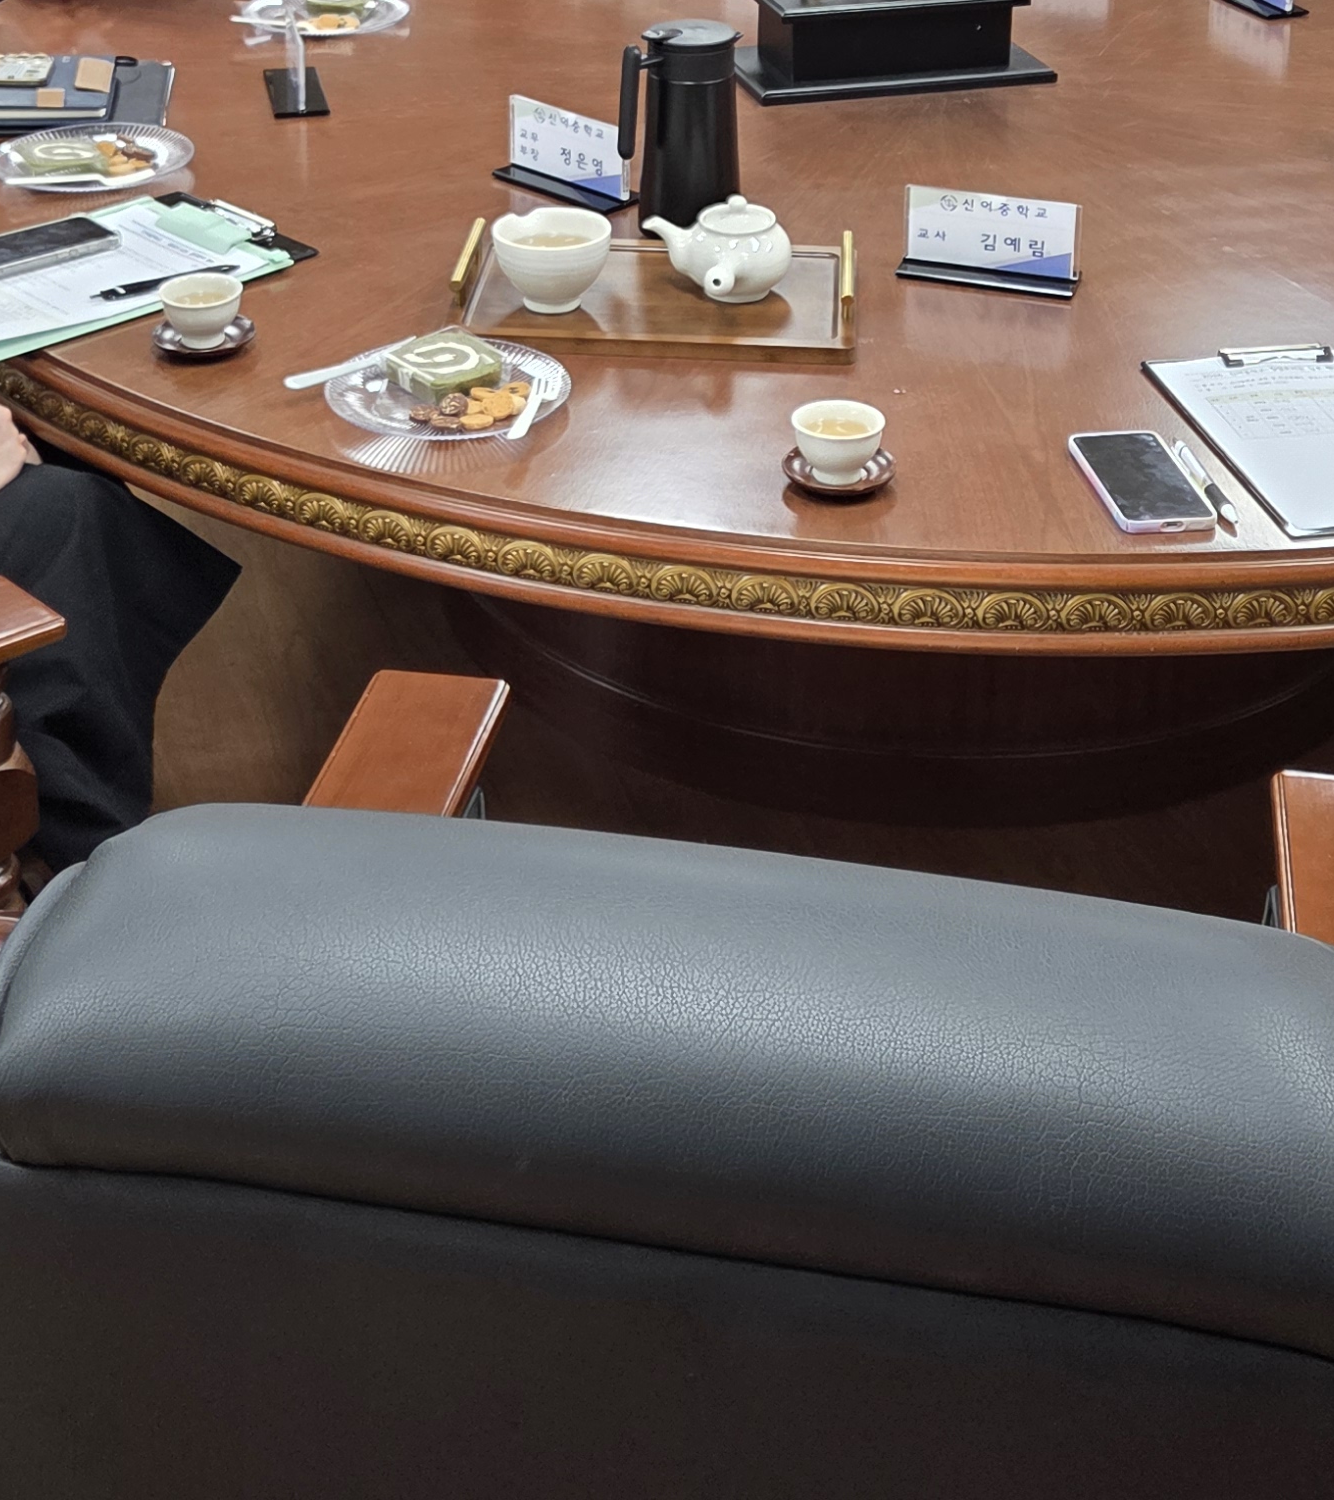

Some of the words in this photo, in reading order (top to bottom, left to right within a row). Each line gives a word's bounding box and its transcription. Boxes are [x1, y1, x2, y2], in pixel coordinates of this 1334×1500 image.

[560, 147, 604, 177] 정은영
[962, 198, 1049, 220] 신어중학교
[917, 228, 947, 242] 교사
[980, 233, 1046, 258] 김예림
